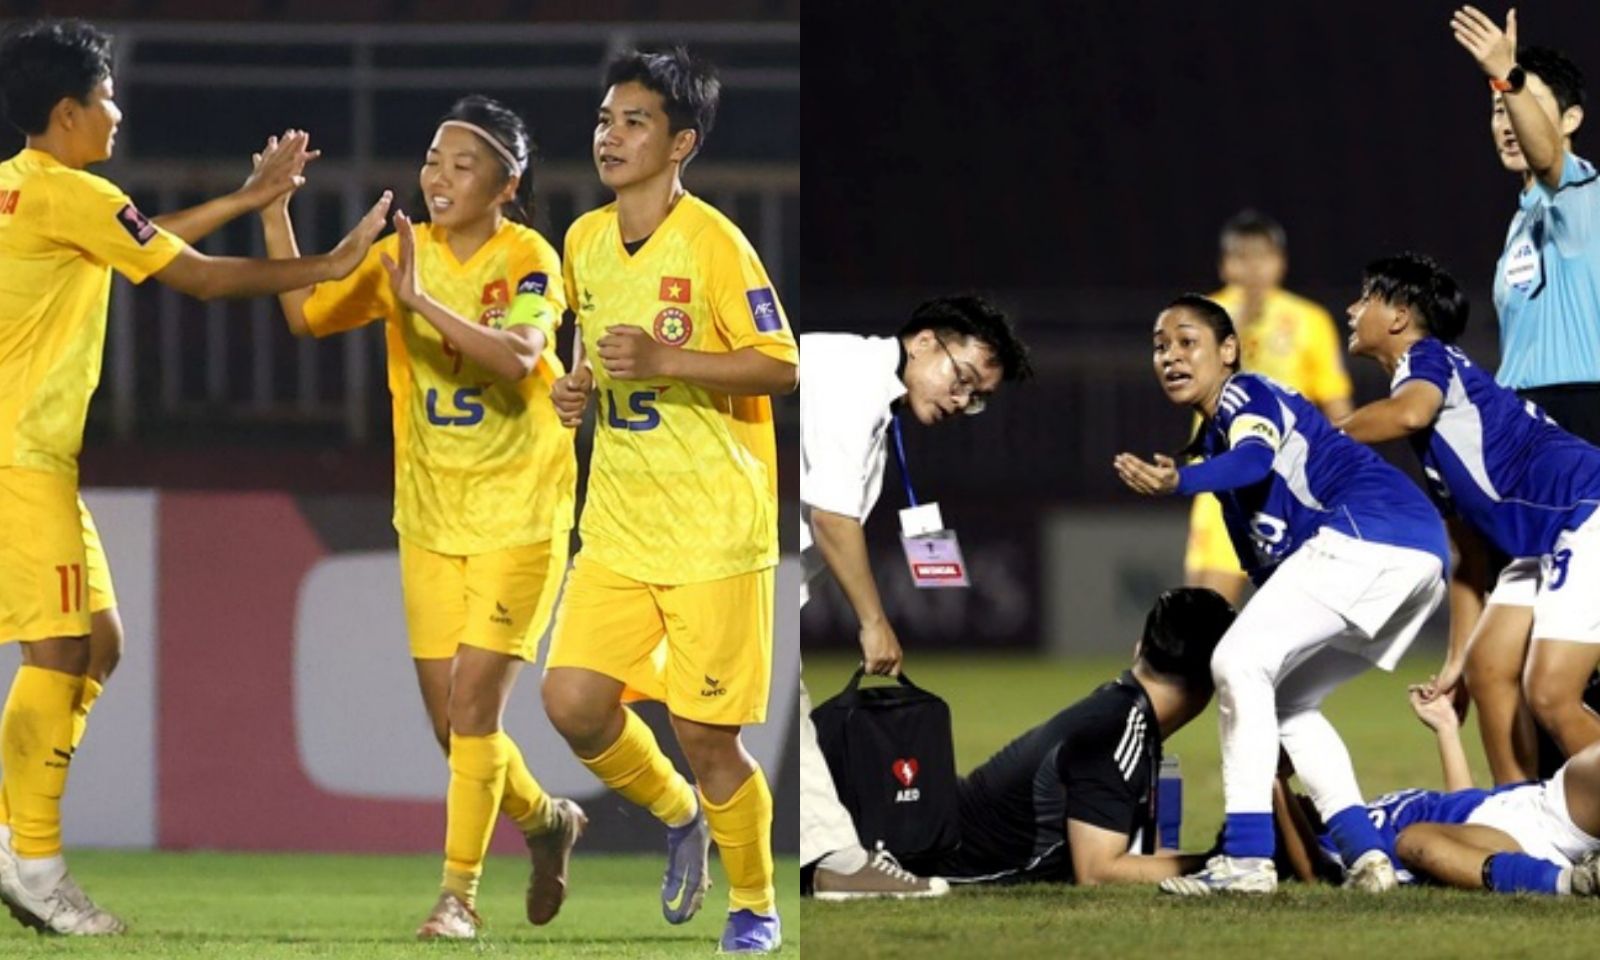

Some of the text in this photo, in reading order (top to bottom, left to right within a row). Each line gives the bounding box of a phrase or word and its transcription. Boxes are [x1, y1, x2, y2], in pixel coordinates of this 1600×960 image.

[426, 387, 485, 426] LS
[607, 388, 661, 431] LS
[55, 564, 81, 613] 11
[894, 787, 920, 803] AED
